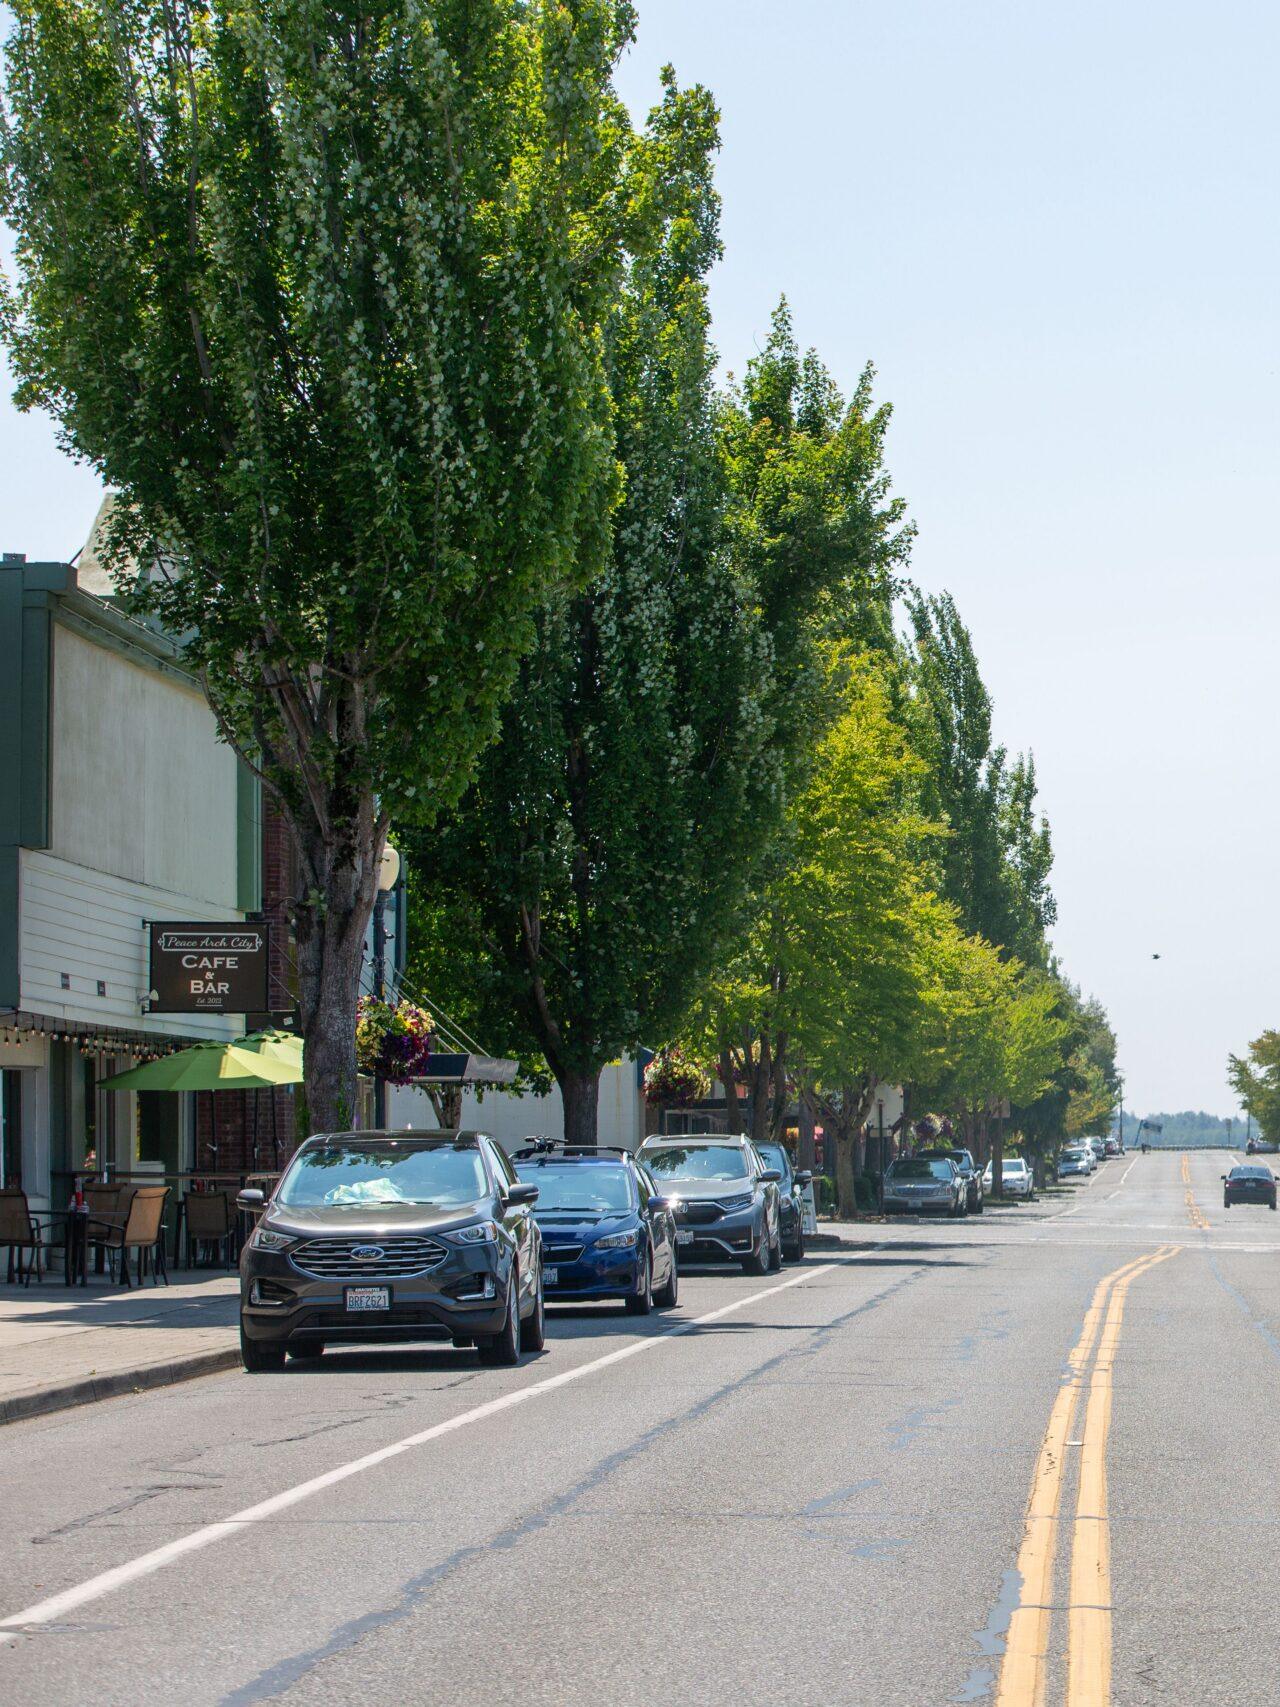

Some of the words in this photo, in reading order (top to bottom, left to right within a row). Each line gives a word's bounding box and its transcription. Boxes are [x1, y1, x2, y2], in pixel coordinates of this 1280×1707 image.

[167, 936, 198, 948] Peace
[199, 936, 228, 948] Arch
[230, 937, 253, 950] City
[204, 971, 215, 980] &
[349, 1295, 386, 1307] BRF2621
